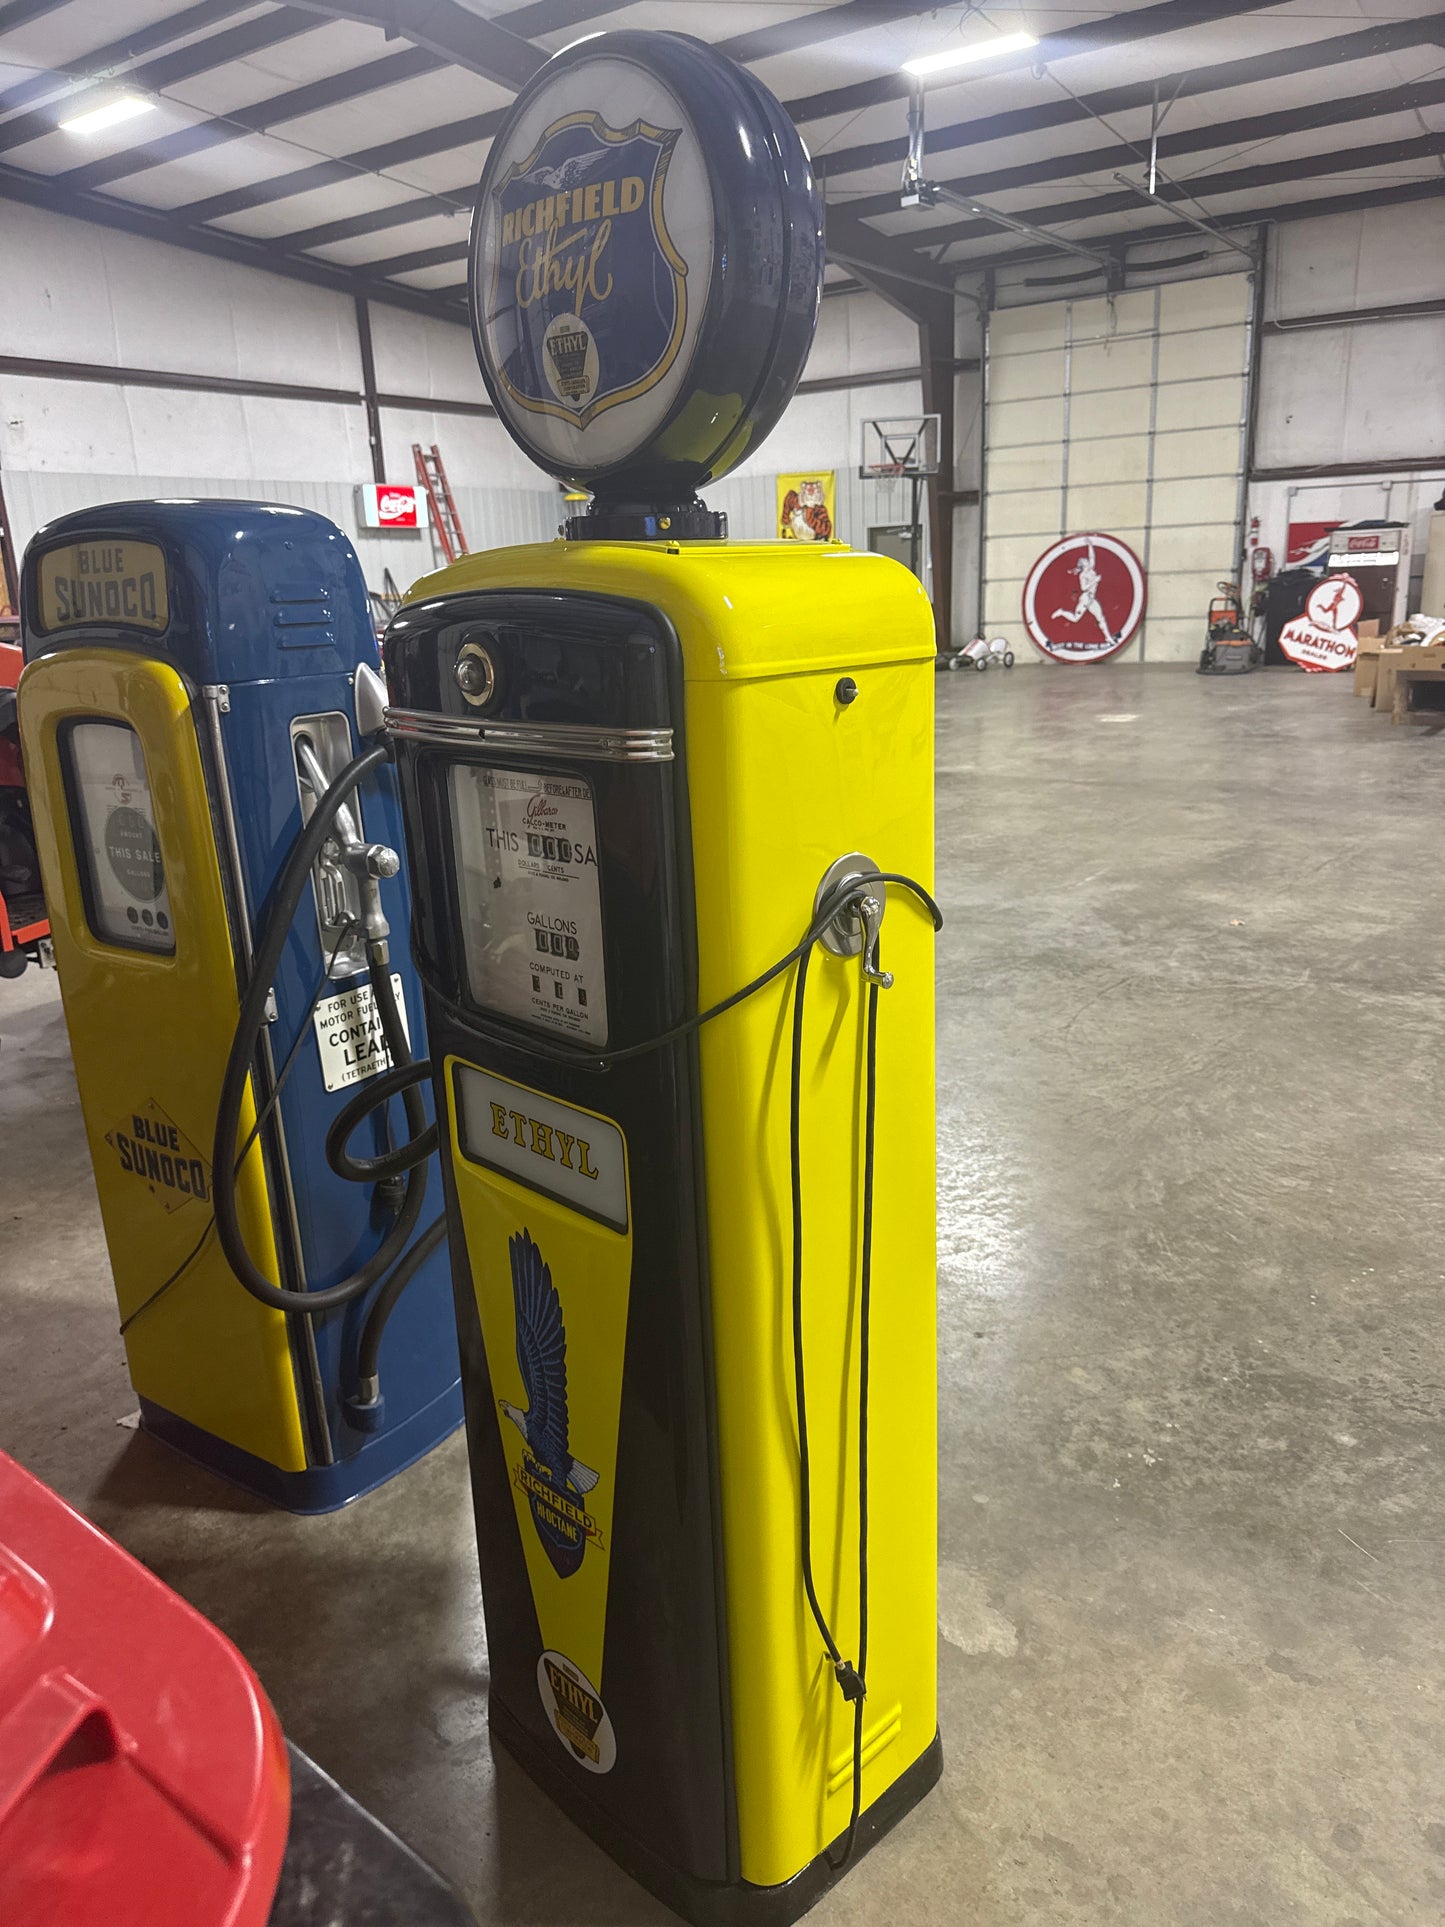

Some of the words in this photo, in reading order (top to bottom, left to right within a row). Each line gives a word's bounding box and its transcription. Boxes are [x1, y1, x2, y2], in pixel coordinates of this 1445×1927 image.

[503, 176, 645, 248] RICHFIELD
[516, 218, 613, 318] Ethyl
[549, 333, 586, 356] ETHYL
[80, 548, 124, 574] BLUE
[55, 571, 157, 622] SUNOCO
[1283, 629, 1356, 659] MARATHON
[486, 827, 519, 852] THIS
[109, 846, 131, 859] THIS
[135, 849, 161, 864] SALE
[527, 911, 578, 935] GALLONS
[529, 962, 570, 980] COMPUTED
[574, 974, 584, 984] AT
[328, 999, 347, 1013] FOR
[350, 990, 369, 1005] USE
[531, 997, 551, 1008] CENTS
[552, 1002, 564, 1012] PER
[320, 1012, 354, 1029] MOTOR
[132, 1114, 179, 1152] BLUE
[490, 1101, 599, 1180] ETHYL
[116, 1132, 206, 1200] SUNOCO
[520, 1470, 592, 1529] RICHFIELD
[548, 1663, 599, 1724] ETHYL
